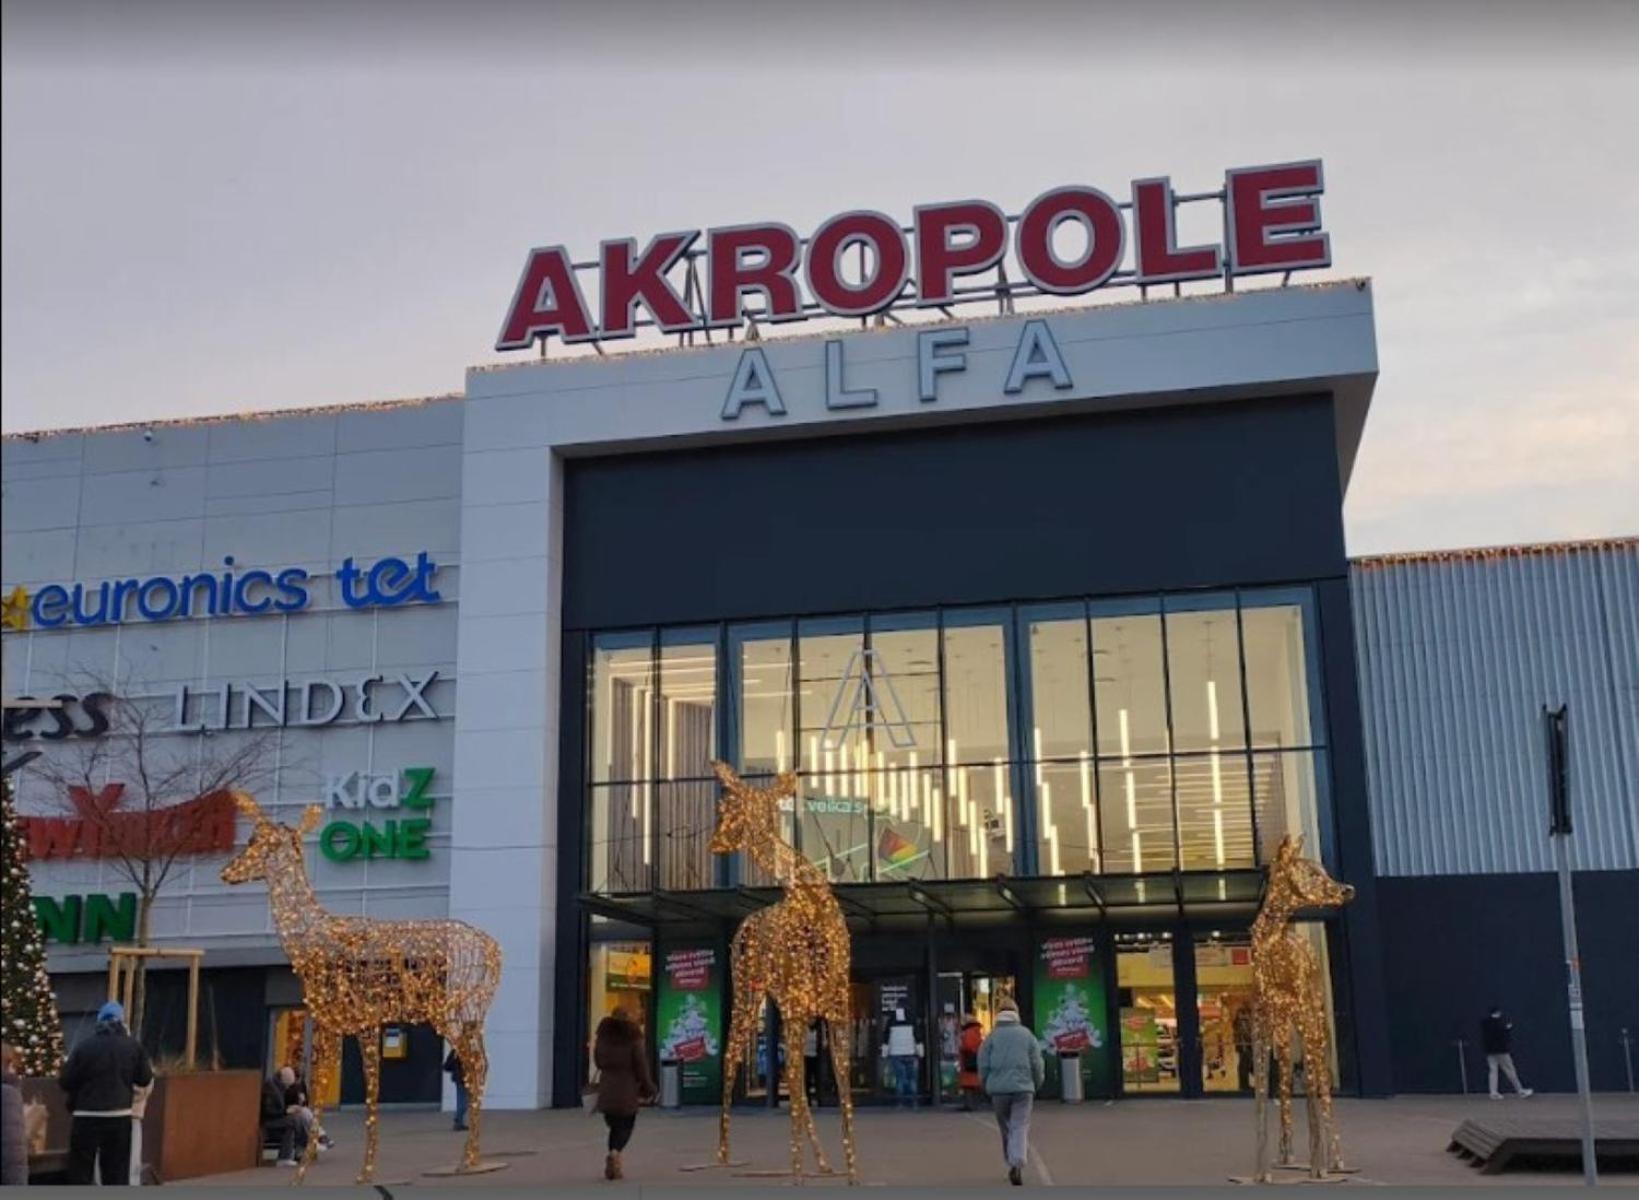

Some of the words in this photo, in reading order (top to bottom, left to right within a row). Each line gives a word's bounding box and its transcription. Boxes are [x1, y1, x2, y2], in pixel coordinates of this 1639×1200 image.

[495, 158, 1332, 352] AKROPOLE
[721, 319, 1074, 420] ALFA
[32, 555, 308, 628] euronics
[336, 551, 442, 609] tet
[174, 671, 440, 734] LINDEX
[319, 818, 432, 862] ONE
